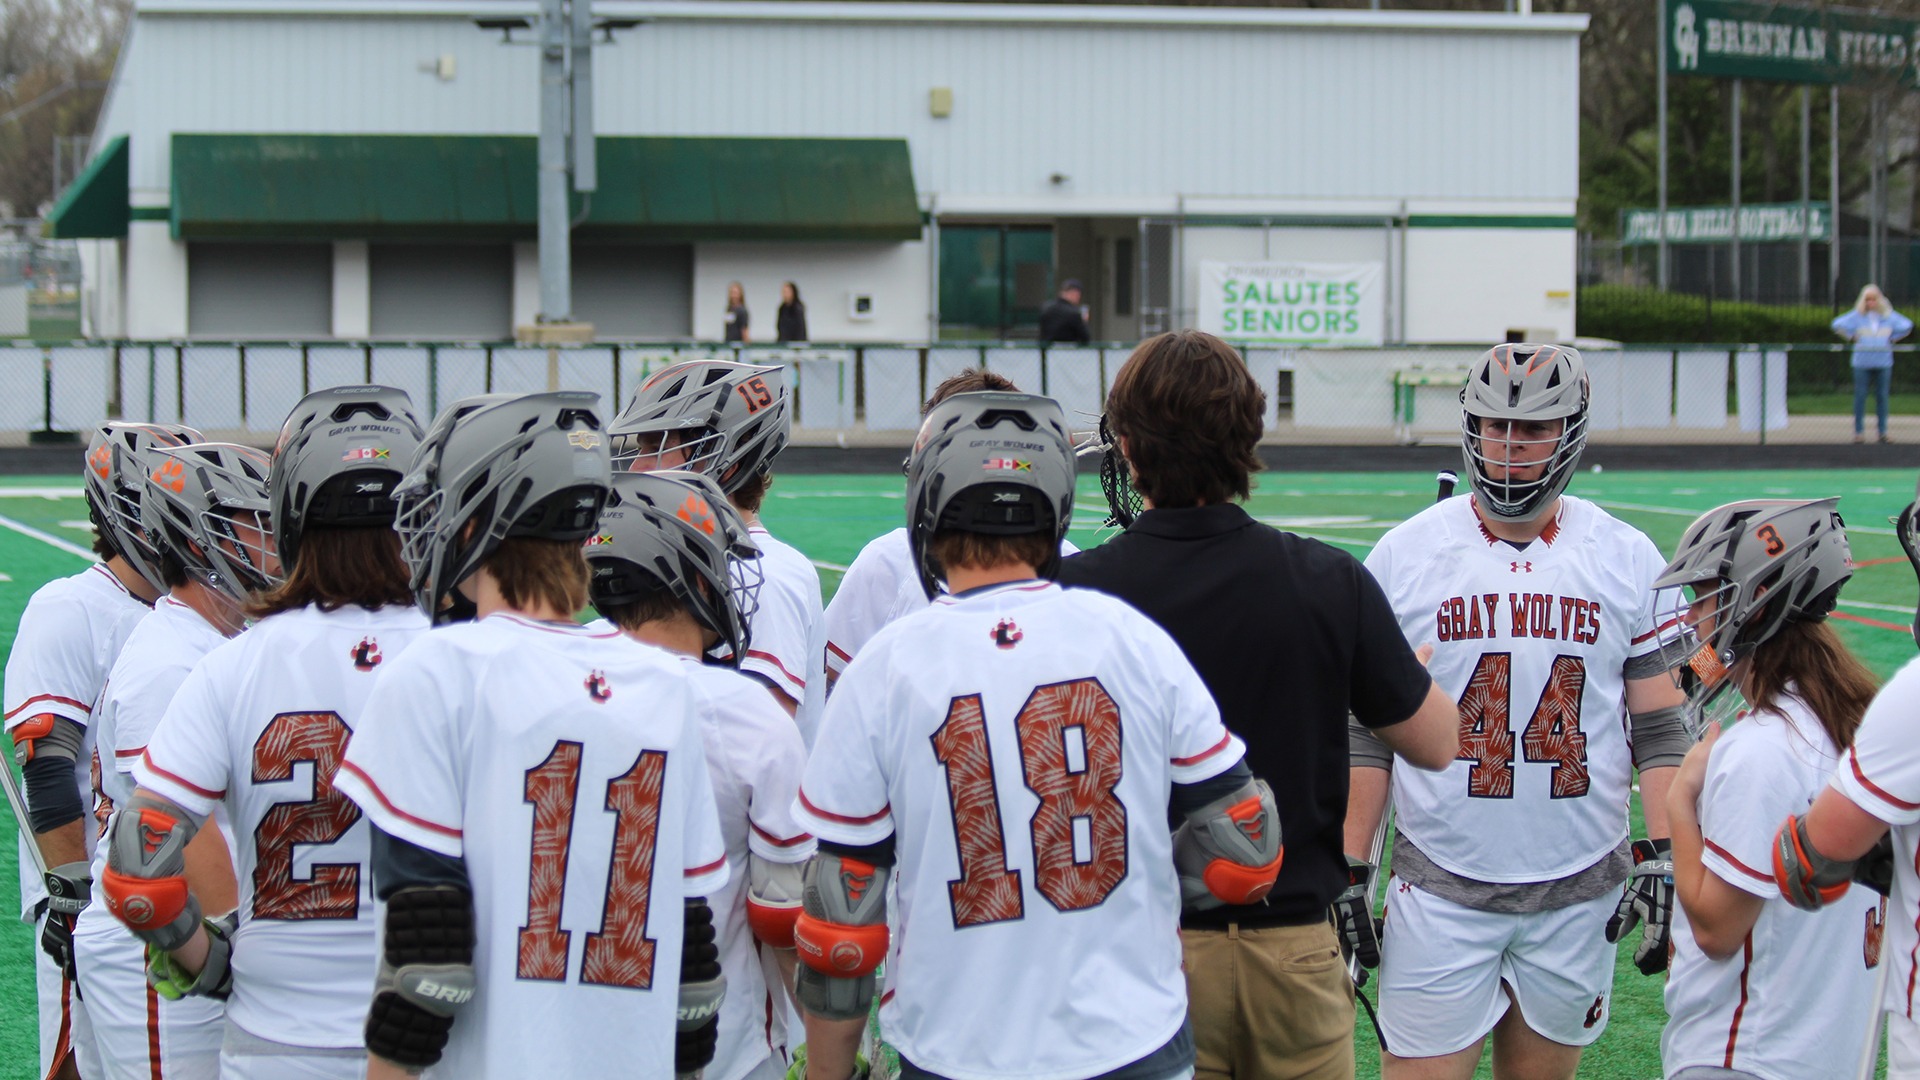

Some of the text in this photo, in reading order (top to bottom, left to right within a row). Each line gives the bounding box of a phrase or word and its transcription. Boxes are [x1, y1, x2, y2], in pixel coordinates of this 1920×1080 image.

[1705, 18, 1828, 60] BRENNAN
[1838, 30, 1907, 68] FIELD
[1222, 279, 1361, 306] SALUTES
[1222, 307, 1360, 334] SENIORS
[736, 375, 774, 415] 15
[328, 425, 401, 437] GRAY WOLVES
[969, 440, 1045, 452] GRAY WOLVES
[1757, 523, 1787, 558] 3
[1436, 593, 1602, 646] GRAY WOLVES
[1454, 652, 1591, 799] 44
[251, 710, 363, 921] 2
[929, 676, 1129, 932] 18
[515, 739, 668, 992] 11
